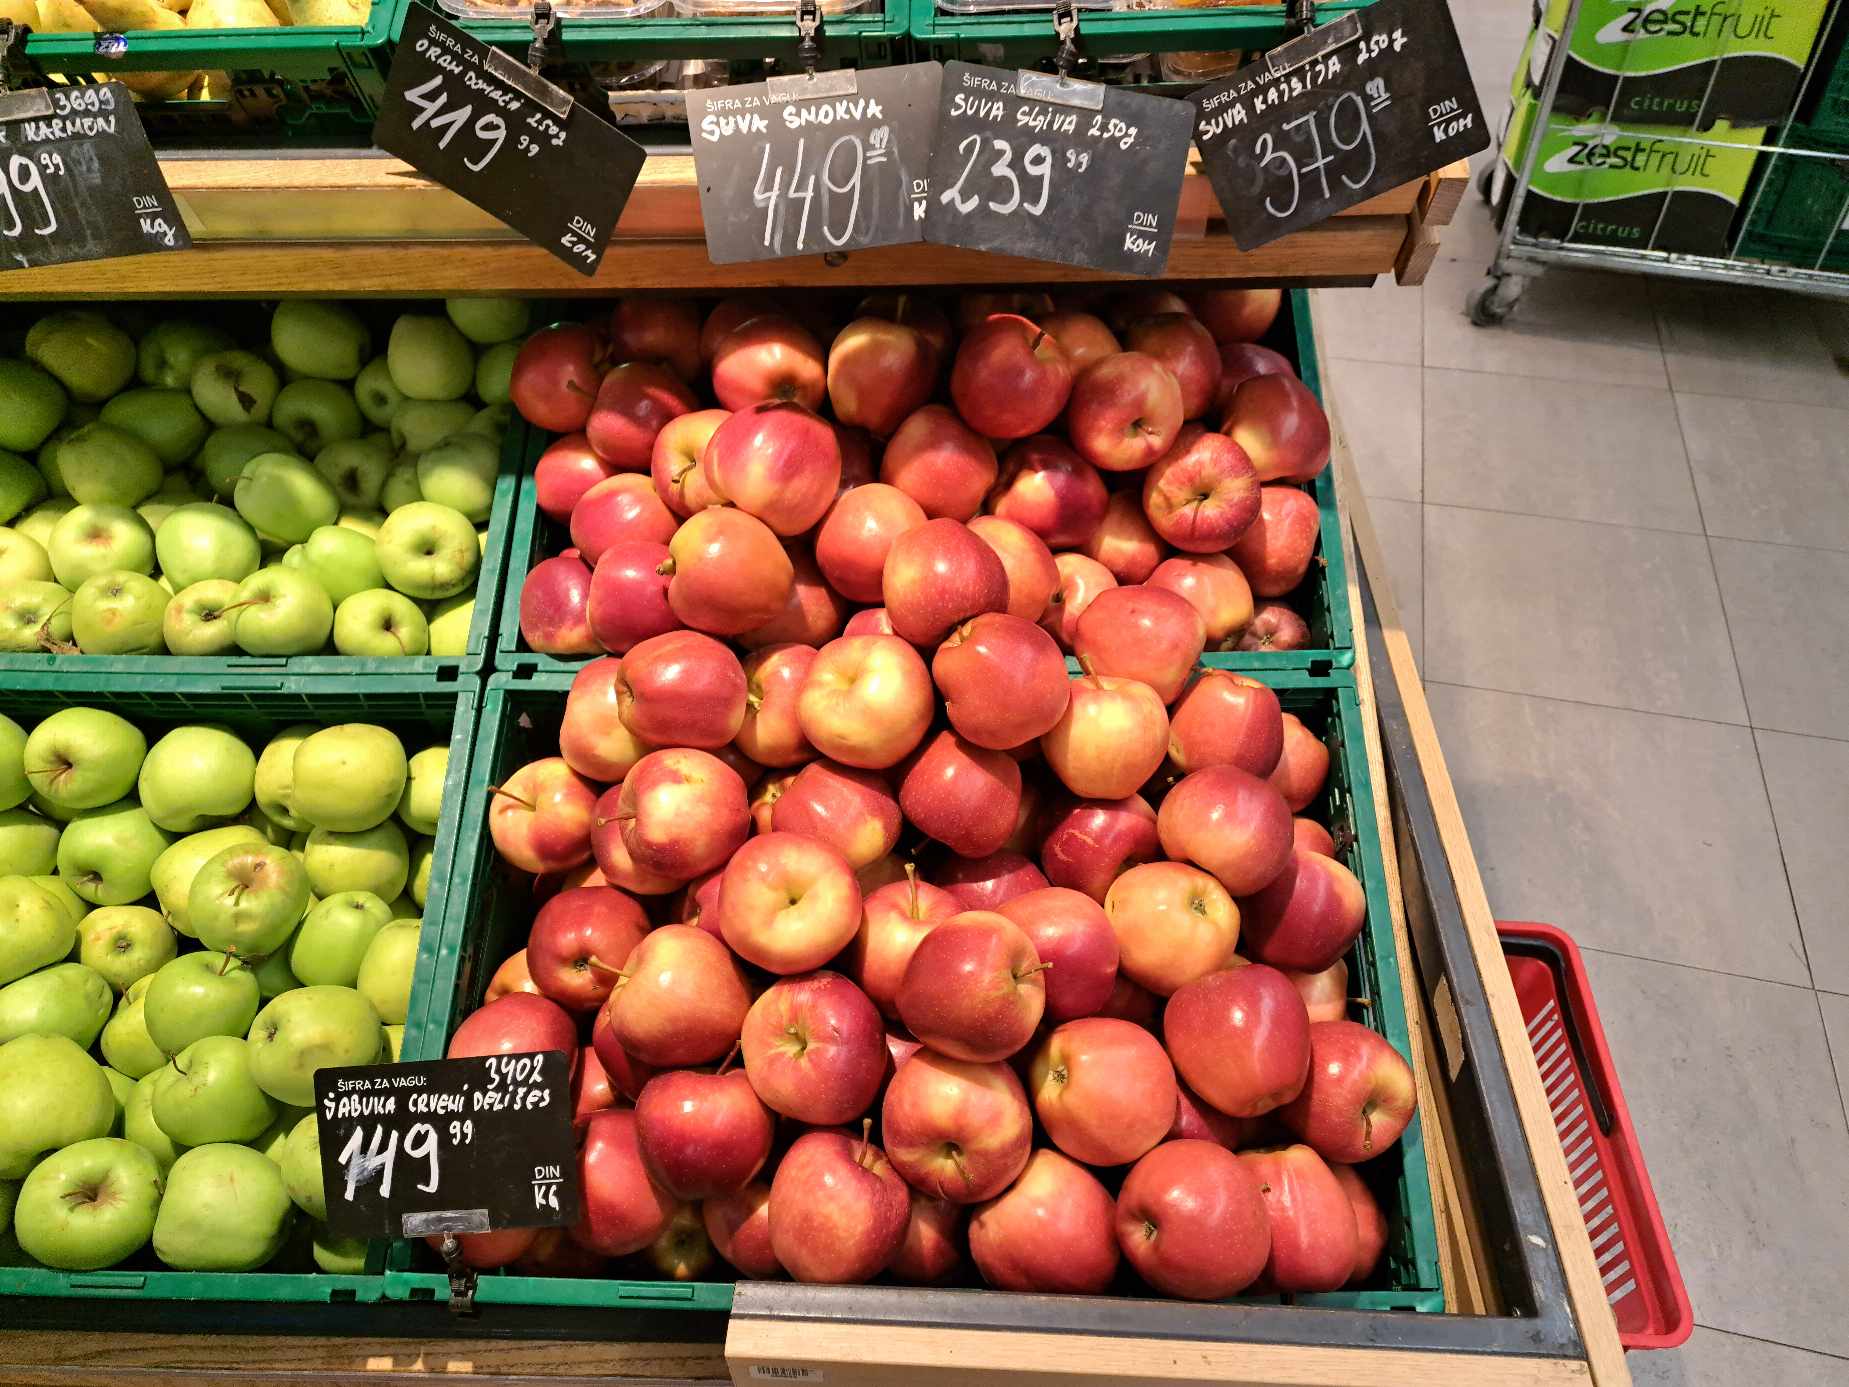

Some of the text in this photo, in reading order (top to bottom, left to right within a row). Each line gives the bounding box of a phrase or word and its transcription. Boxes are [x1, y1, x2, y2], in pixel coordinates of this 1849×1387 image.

[415, 38, 464, 76] ORAH
[427, 24, 463, 55] ŠIFRA
[463, 48, 480, 66] ZA
[962, 72, 998, 91] ŠIFRA
[1000, 81, 1017, 95] ZA
[1202, 89, 1239, 112] ŠIFRA
[1238, 80, 1256, 95] ZA
[54, 86, 116, 116] 3699
[705, 98, 742, 112] ŠIFRA
[744, 96, 761, 107] ZA
[1428, 97, 1458, 120] DIN
[1629, 93, 1700, 112] citrus
[403, 74, 541, 172] 419 99
[700, 113, 769, 142] SUVA
[950, 93, 1005, 122] SUVA
[1087, 115, 1139, 150] 250g
[1199, 102, 1248, 141] SUVA
[1433, 113, 1474, 144] KOM
[40, 152, 65, 176] 99
[1254, 91, 1378, 219] 379
[939, 134, 1091, 217] 239 99
[132, 195, 158, 208] DIN
[752, 134, 862, 249] 449
[572, 215, 597, 238] DIN
[1133, 211, 1158, 226] DIN
[560, 233, 598, 264] KOM
[1123, 232, 1157, 257] KOM
[337, 1075, 427, 1092] ŠIFRA ZA VAGU:
[484, 1053, 545, 1090] 3402
[337, 1118, 474, 1202] 149 99
[534, 1165, 561, 1180] DIN
[534, 1184, 560, 1211] KG
